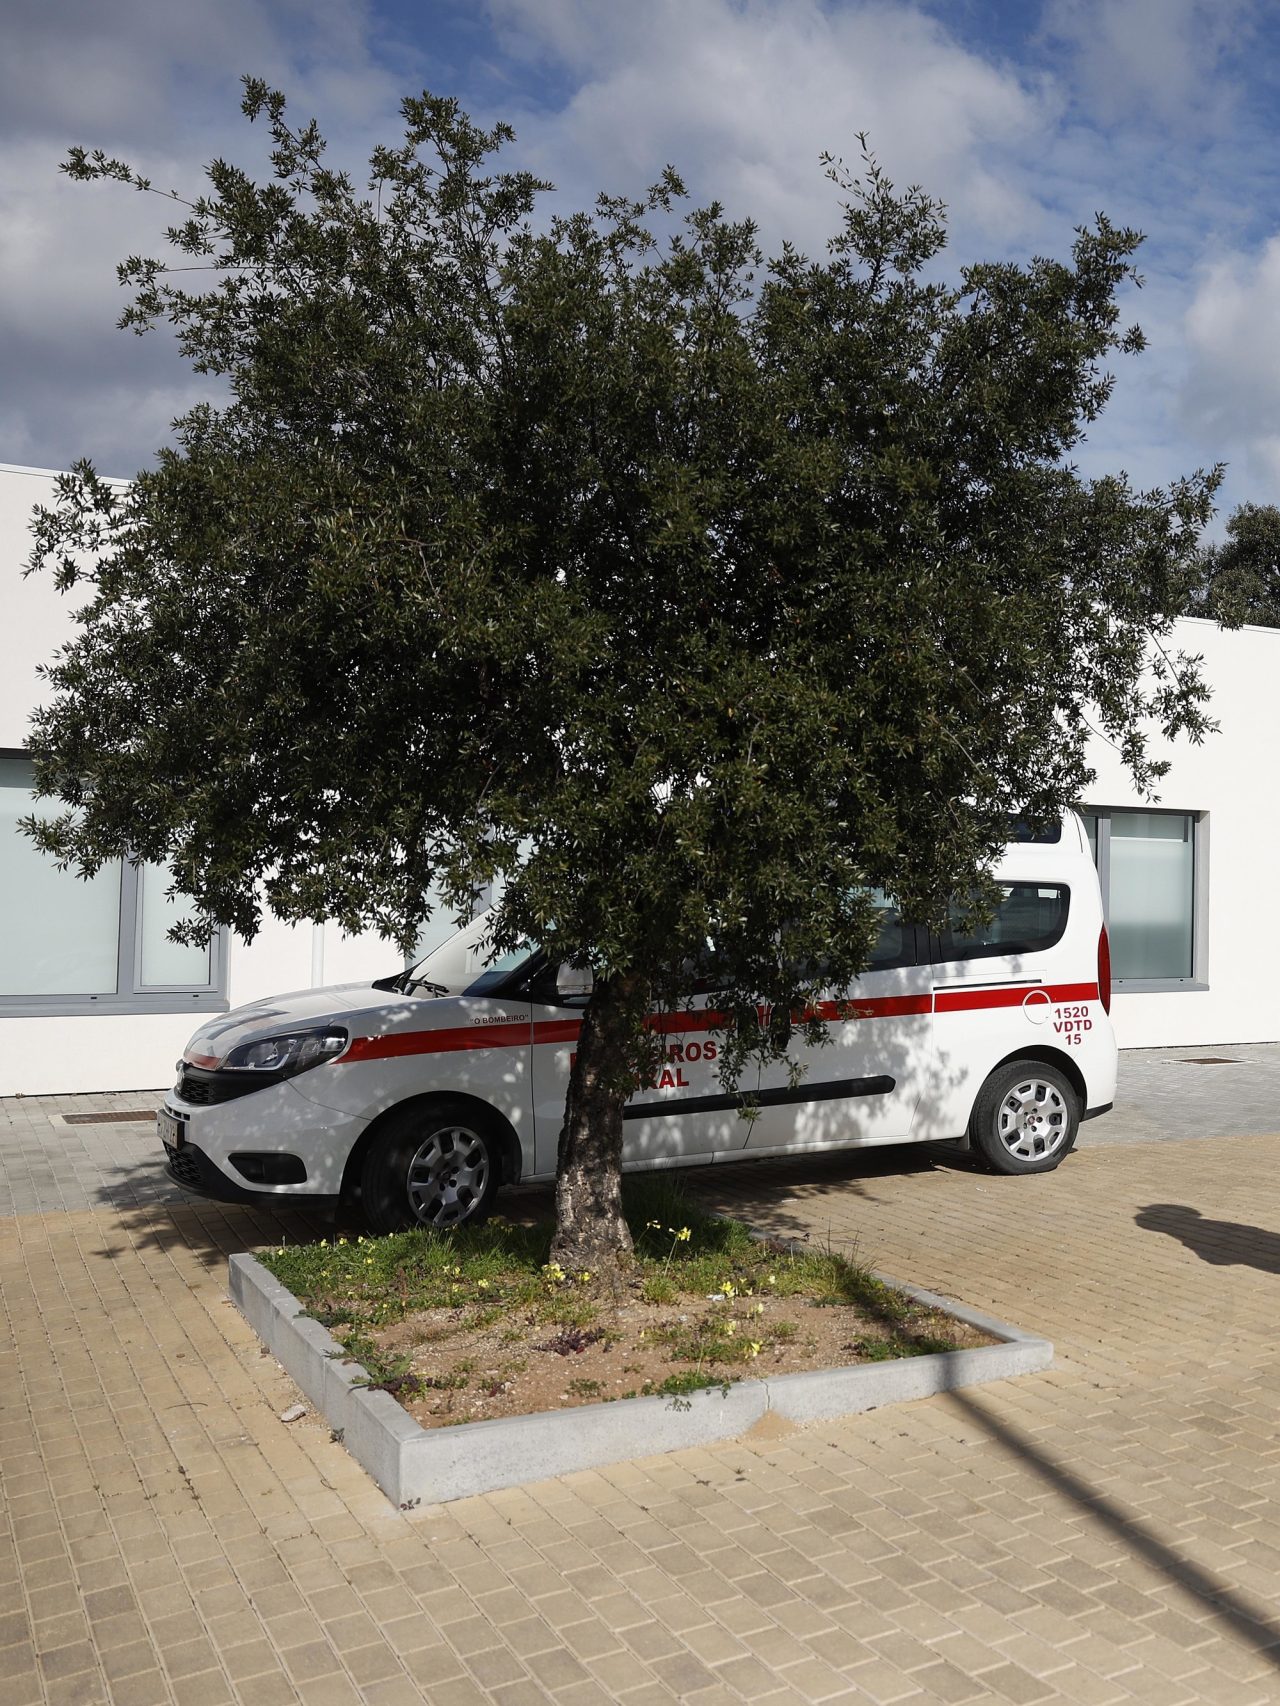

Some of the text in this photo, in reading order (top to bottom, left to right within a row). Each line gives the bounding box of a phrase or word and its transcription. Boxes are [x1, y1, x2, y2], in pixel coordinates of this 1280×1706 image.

[1054, 1005, 1089, 1019] 1520
[1053, 1019, 1093, 1033] VDTD
[1065, 1033, 1082, 1046] 15
